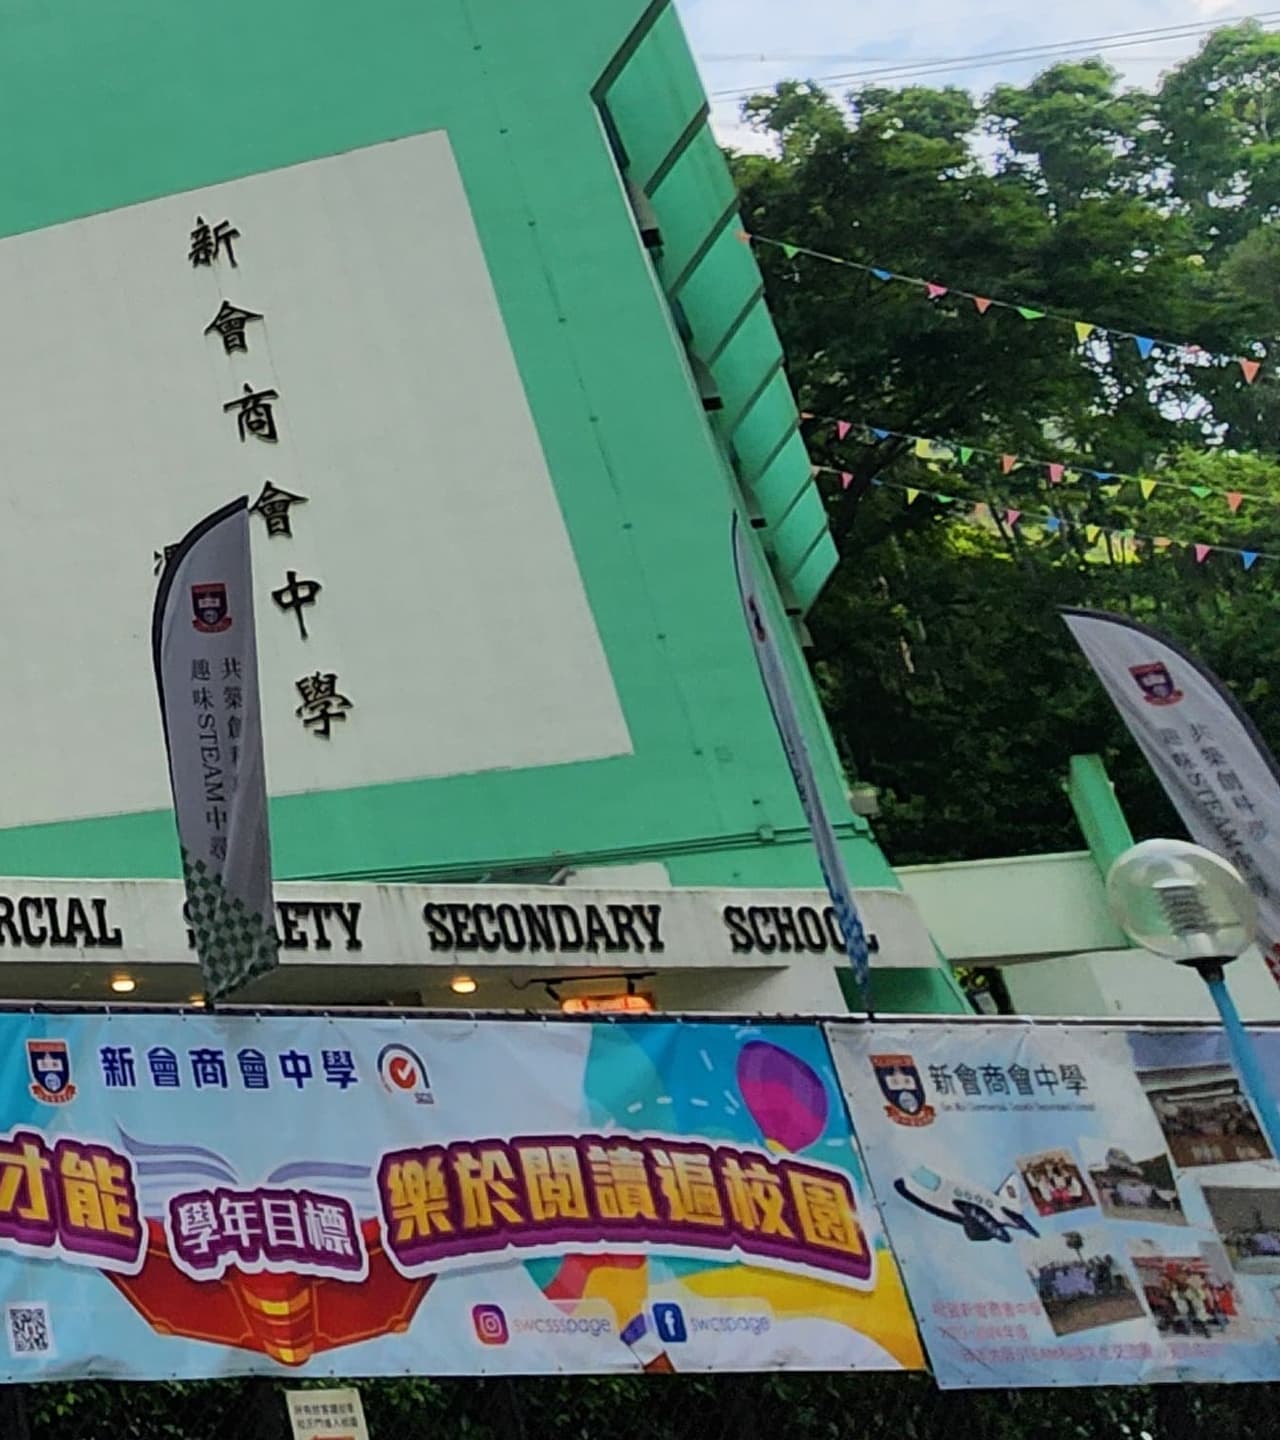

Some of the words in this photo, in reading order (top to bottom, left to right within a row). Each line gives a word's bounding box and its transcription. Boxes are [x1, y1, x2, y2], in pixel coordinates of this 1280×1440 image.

[188, 216, 354, 741] 新會商會中學
[422, 902, 665, 954] SECONDARY
[723, 906, 880, 953] SCHOO
[100, 1047, 359, 1090] 新會商會中學
[928, 1062, 1089, 1097] 新會商會中學
[177, 1191, 354, 1256] 學年目標
[386, 1140, 860, 1257] 樂於閱讀遍校園
